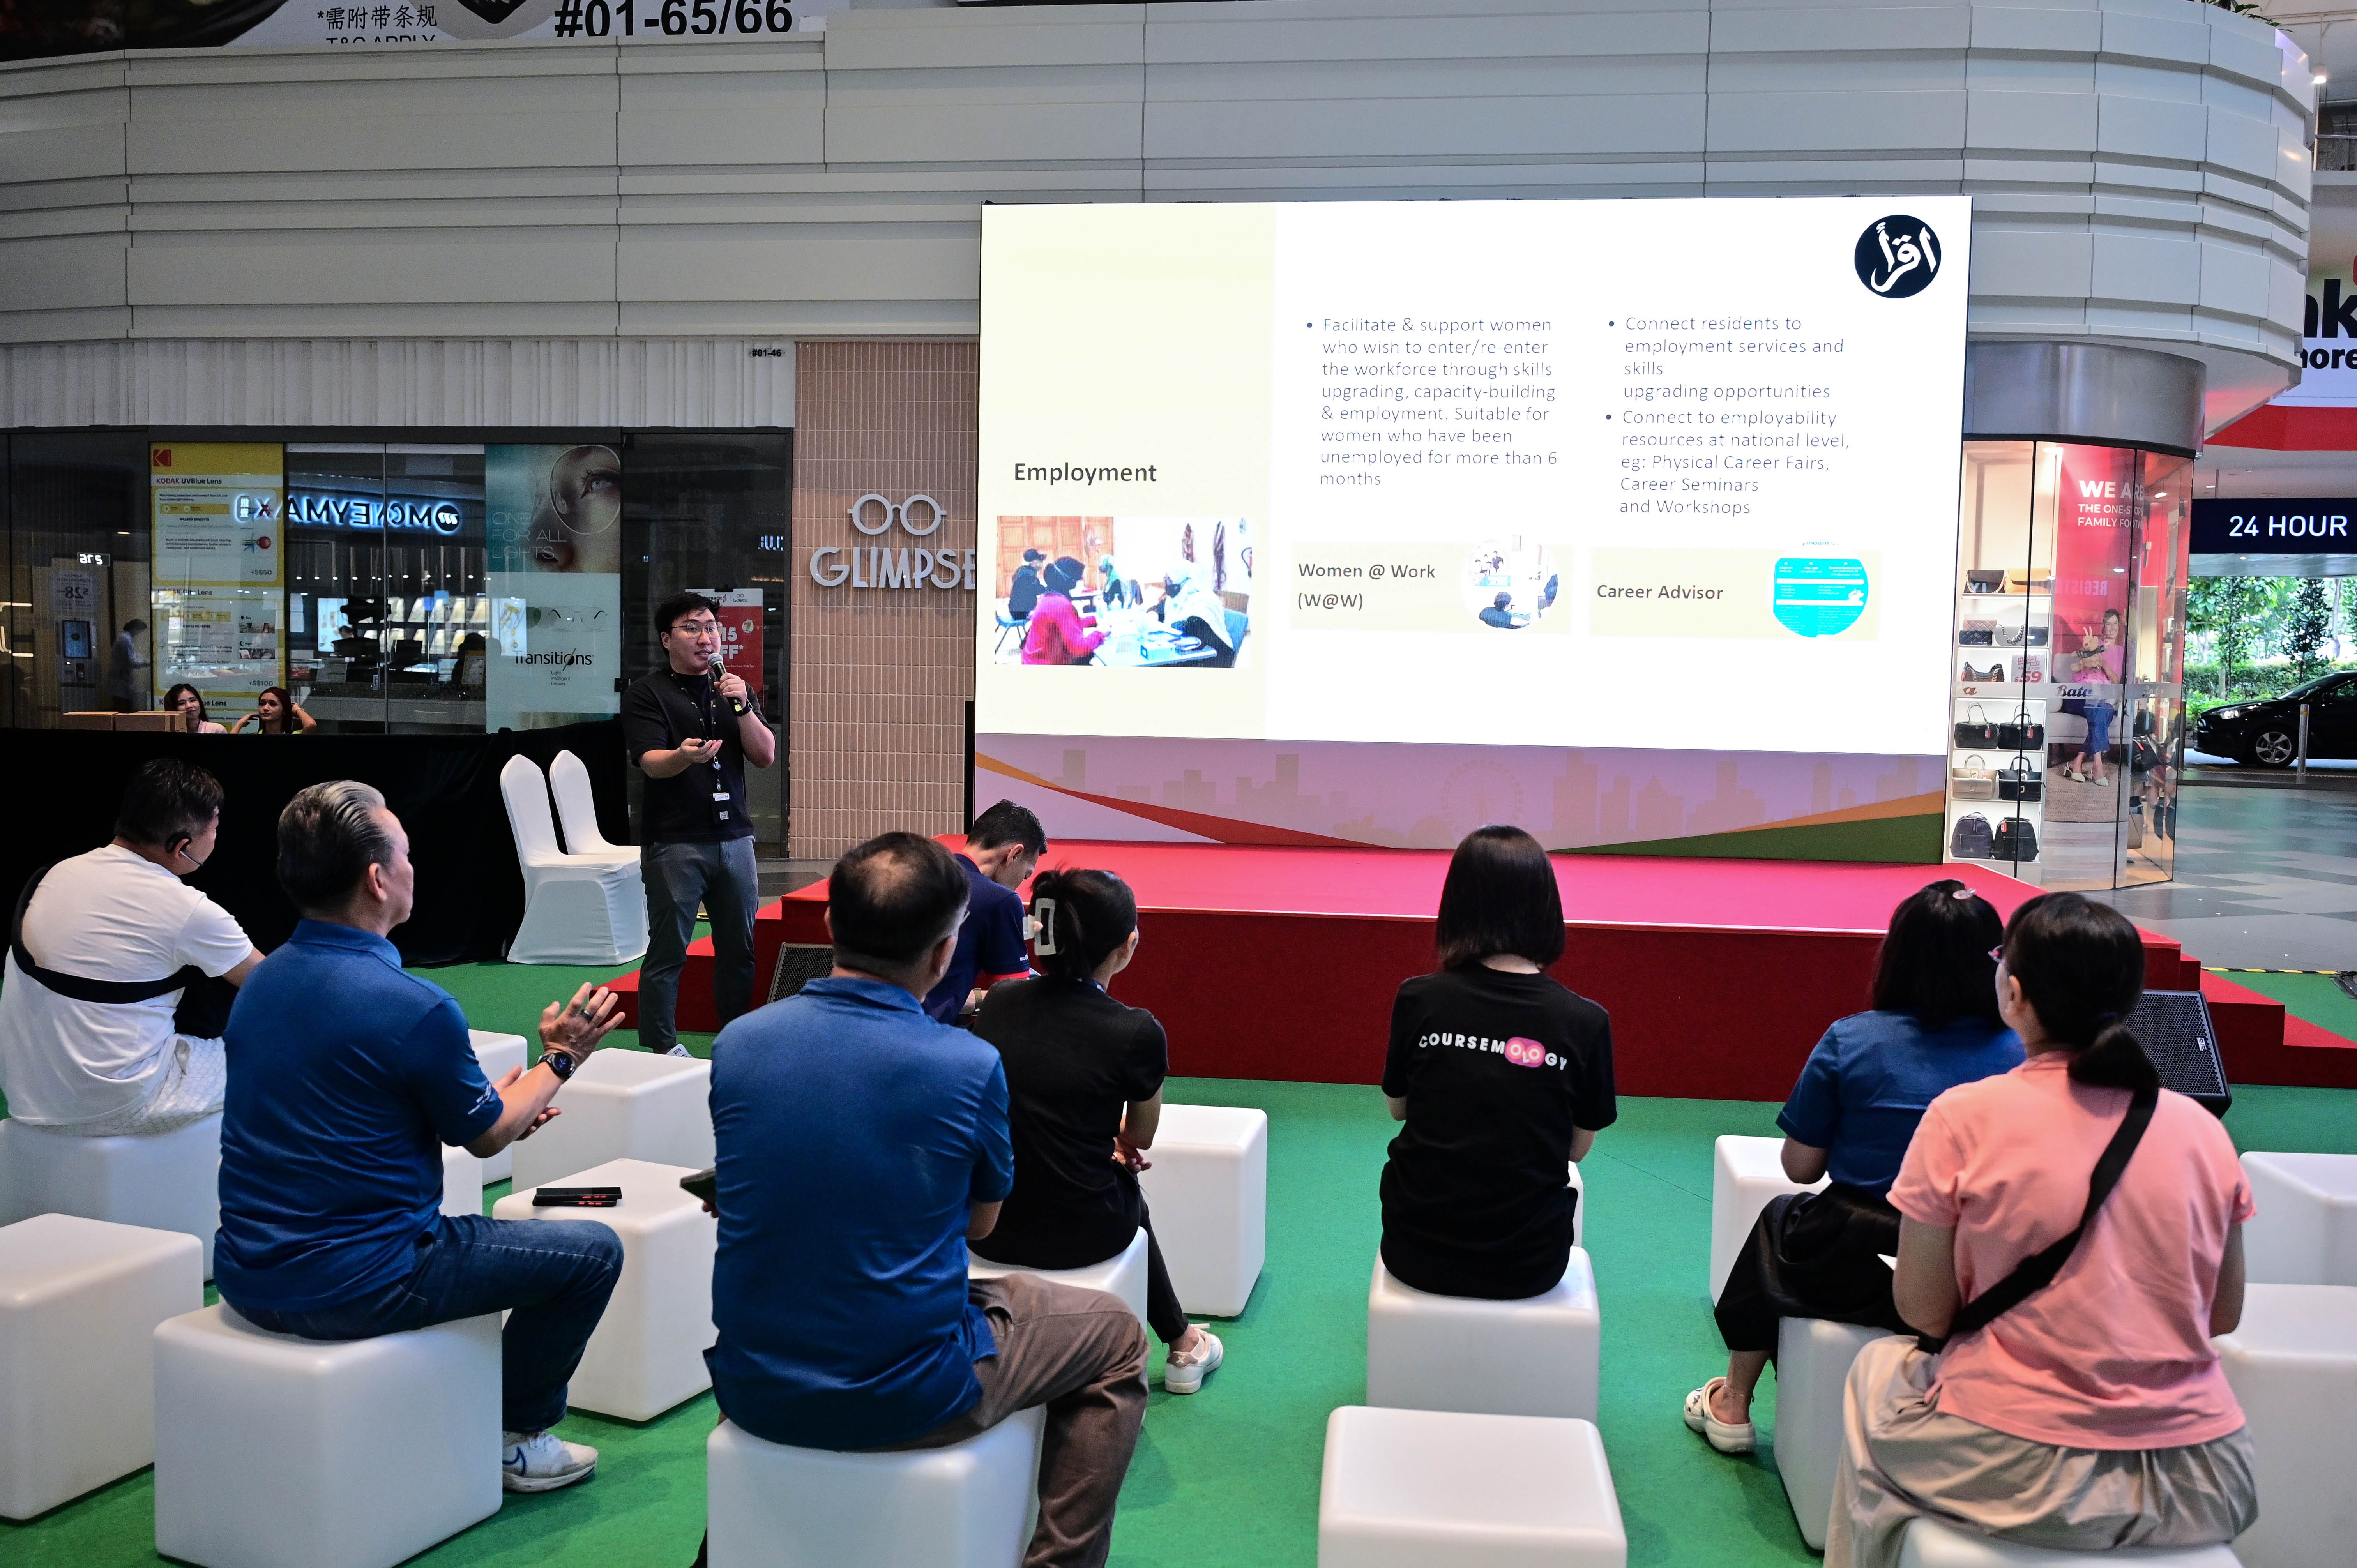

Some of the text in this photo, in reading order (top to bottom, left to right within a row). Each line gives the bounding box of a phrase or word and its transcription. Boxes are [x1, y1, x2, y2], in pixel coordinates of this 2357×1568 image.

[554, 0, 793, 37] #01-65/66
[1324, 318, 1551, 335] Facilitate & support women
[1626, 316, 1801, 330] Connect residents to
[751, 348, 782, 357] #01-46
[1323, 339, 1548, 356] who wish to enter/re-enter
[1625, 339, 1843, 356] employment services and
[1322, 362, 1552, 380] the workforce through skills
[1624, 361, 1663, 375] skills
[1323, 384, 1555, 402] upgrading, capacity-building
[1624, 383, 1830, 401] upgrading opportunities
[1322, 406, 1549, 423] & employment. Suitable for
[1623, 410, 1836, 427] Connect to employability
[1321, 428, 1511, 442] women who have been
[1623, 433, 1848, 450] resources at national level,
[1321, 450, 1557, 466] unemployed for more than 6
[1622, 455, 1829, 472] eg: Physical Career Fairs,
[1015, 462, 1157, 486] Employment
[1320, 471, 1380, 485] months
[1621, 477, 1758, 491] Career Seminars
[2078, 480, 2116, 498] WE
[1620, 499, 1750, 517] and Workshops
[2078, 504, 2101, 513] THE
[492, 512, 531, 525] ONE
[2078, 517, 2117, 527] FAMILY
[2229, 515, 2348, 537] 24 HOUR
[492, 529, 567, 542] FOR ALL
[492, 546, 555, 559] LIGHTS
[809, 546, 975, 590] GLIMPSE
[1298, 563, 1435, 580] Women @ Work
[1597, 584, 1723, 599] Career Advisor
[1298, 592, 1363, 611] (W@W)
[513, 650, 593, 666] Transitions
[2057, 684, 2093, 697] Bata
[1419, 1032, 1567, 1070] COURSEMOLOGY
